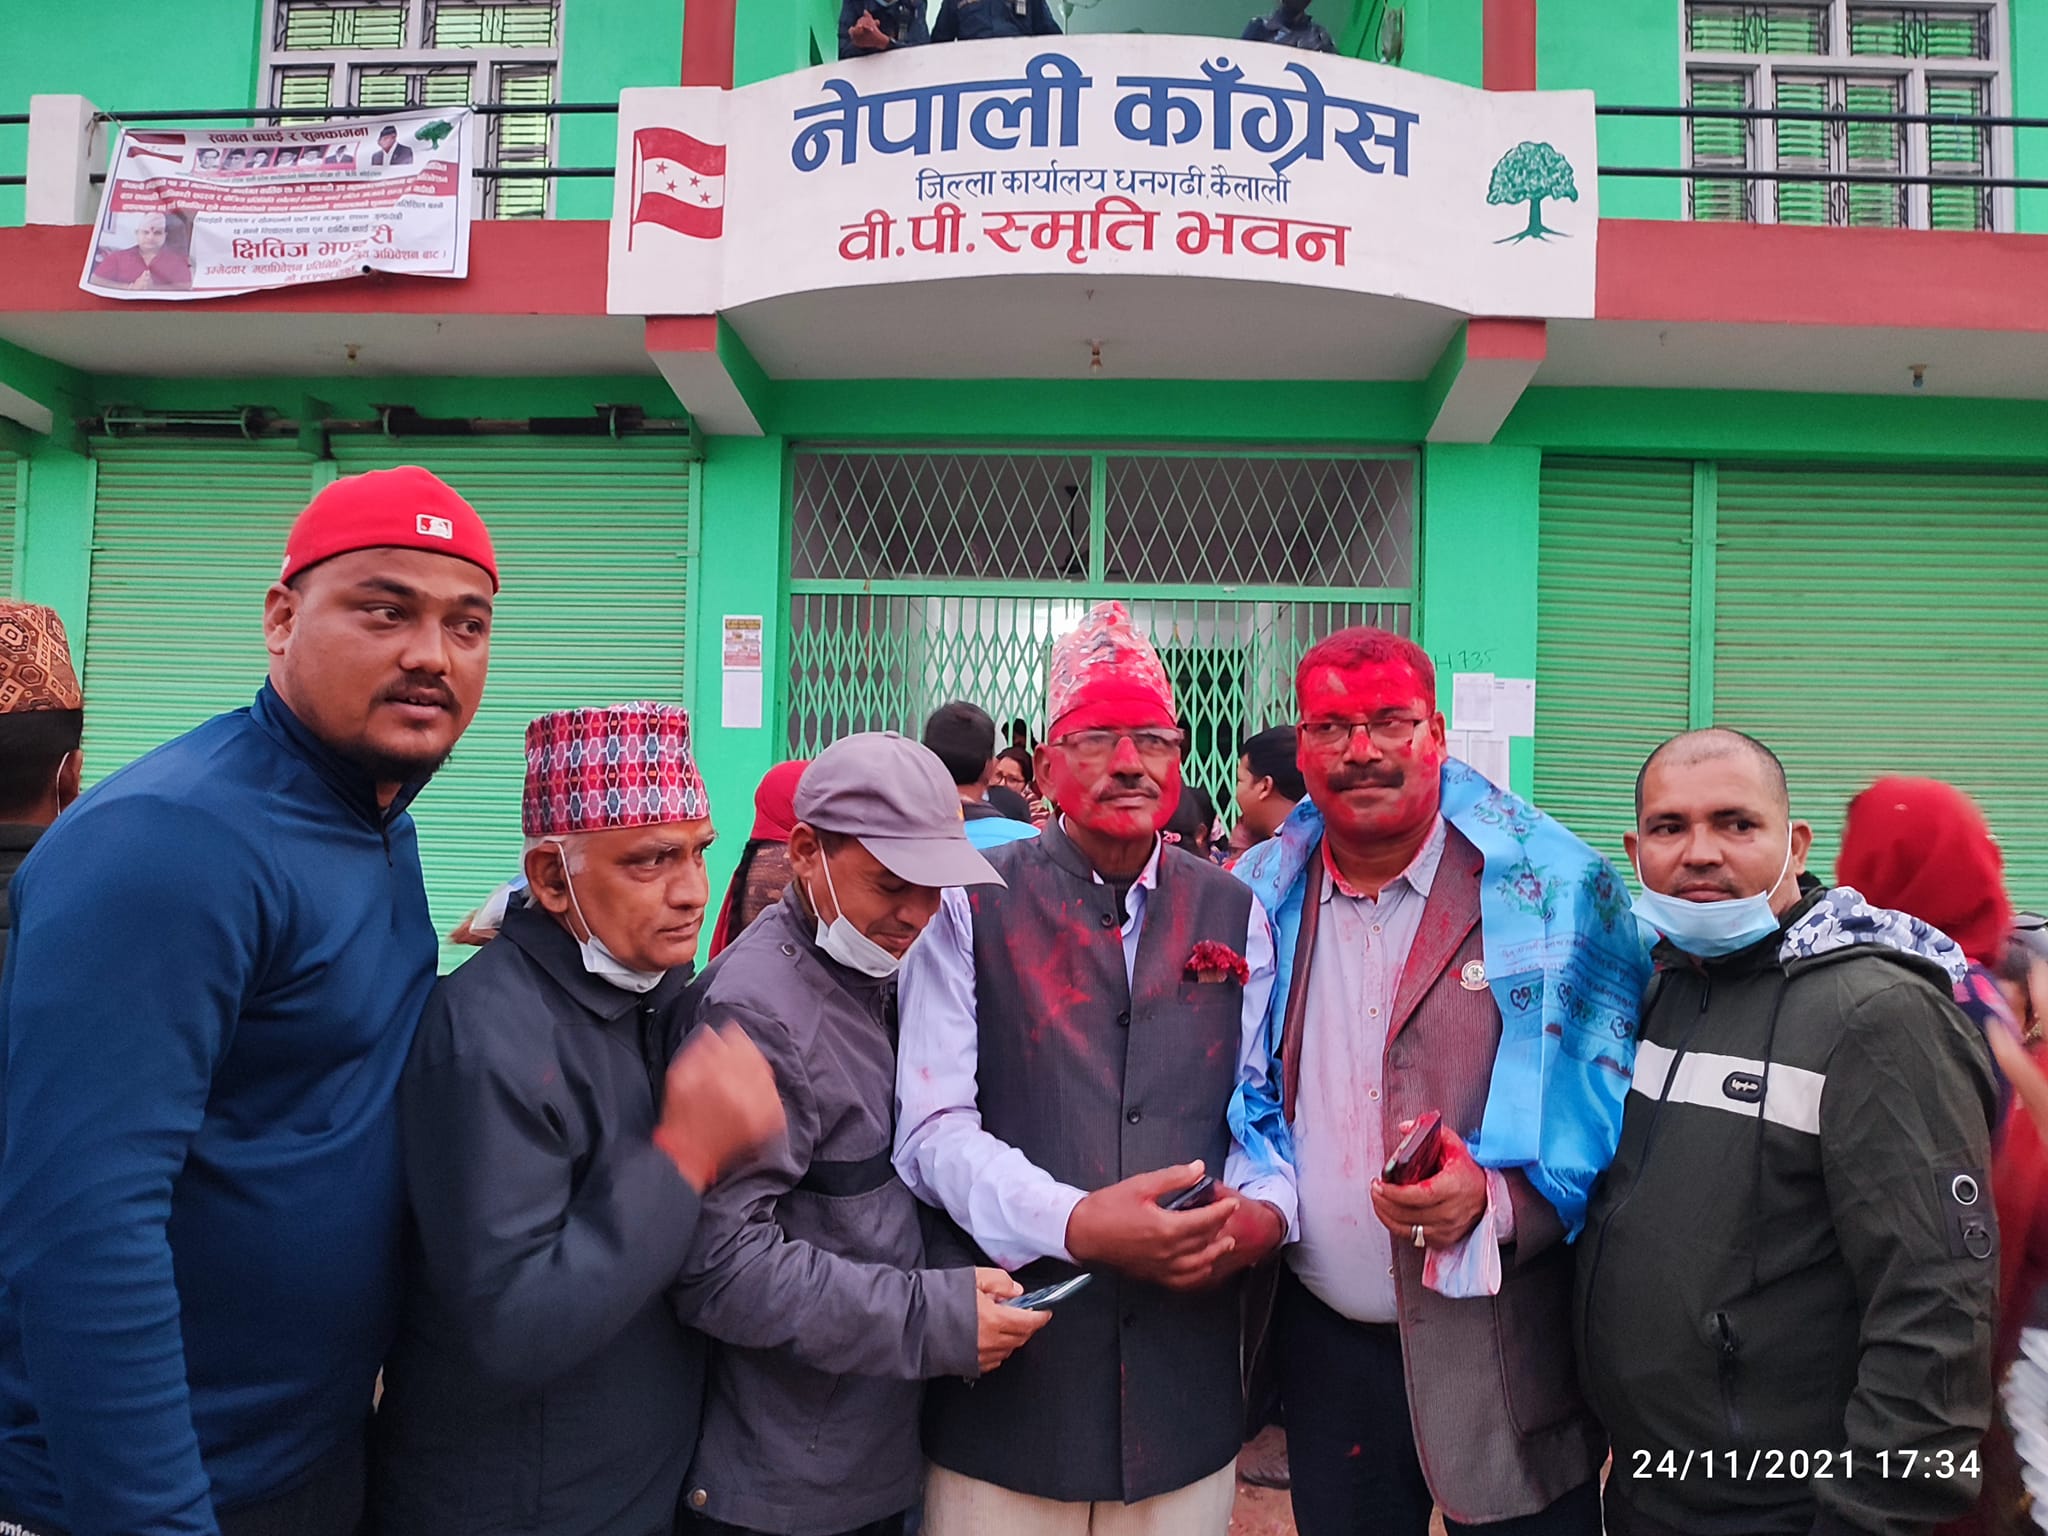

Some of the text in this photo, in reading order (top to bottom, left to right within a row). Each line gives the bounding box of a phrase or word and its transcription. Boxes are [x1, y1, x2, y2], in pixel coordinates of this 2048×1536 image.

[791, 52, 1420, 177] नेपाली काँग्रेस
[915, 167, 997, 201] जिल्ला
[1002, 159, 1108, 194] कार्यालय
[231, 236, 308, 260] क्षितिज
[982, 195, 1161, 264] स्मृति
[1176, 210, 1353, 267] भवन
